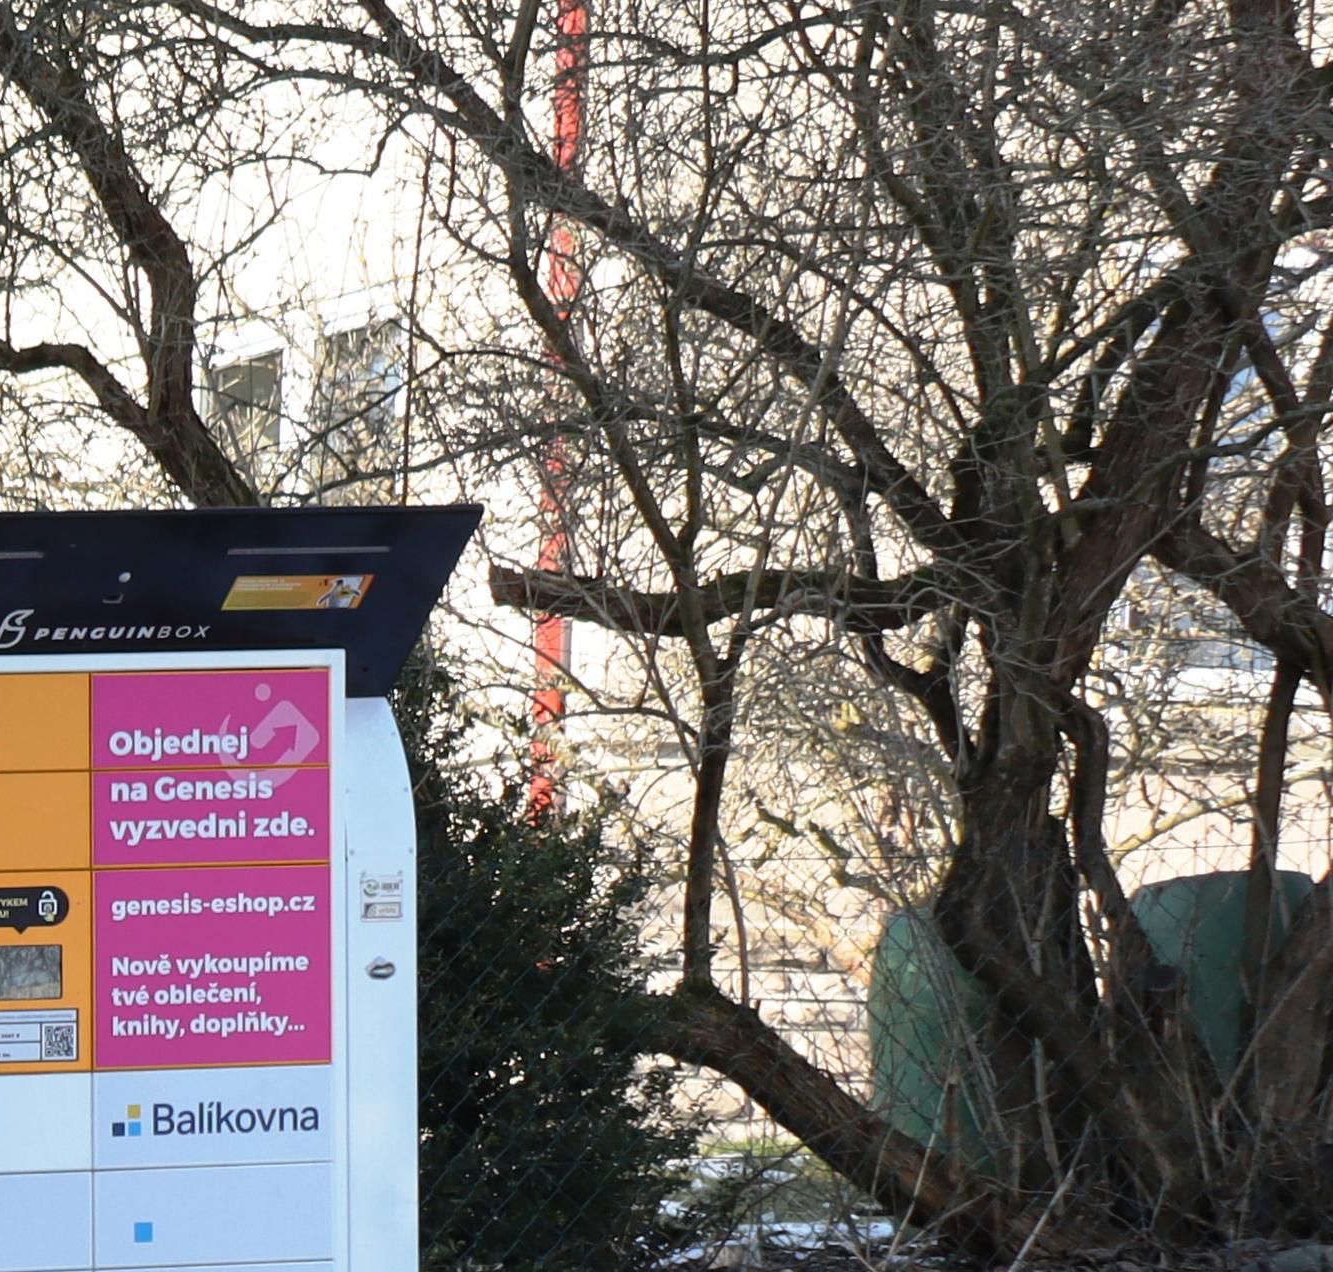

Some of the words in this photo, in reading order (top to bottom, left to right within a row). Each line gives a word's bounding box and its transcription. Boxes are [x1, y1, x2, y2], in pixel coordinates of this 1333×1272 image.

[34, 624, 211, 641] PENGUINBOX
[109, 726, 248, 761] Objednej
[111, 781, 148, 802] na
[154, 772, 273, 801] Genesis
[109, 811, 246, 846] vyzvedni
[253, 811, 315, 837] zde.
[111, 893, 315, 921] genesis-eshop.cz
[112, 953, 172, 976] Nově
[176, 951, 309, 978] vykoupíme
[112, 985, 149, 1006] tvé
[154, 981, 262, 1005] oblečení,
[112, 1014, 185, 1039] knihy,
[190, 1011, 305, 1037] doplňky...
[152, 1101, 319, 1136] Balíkovna
